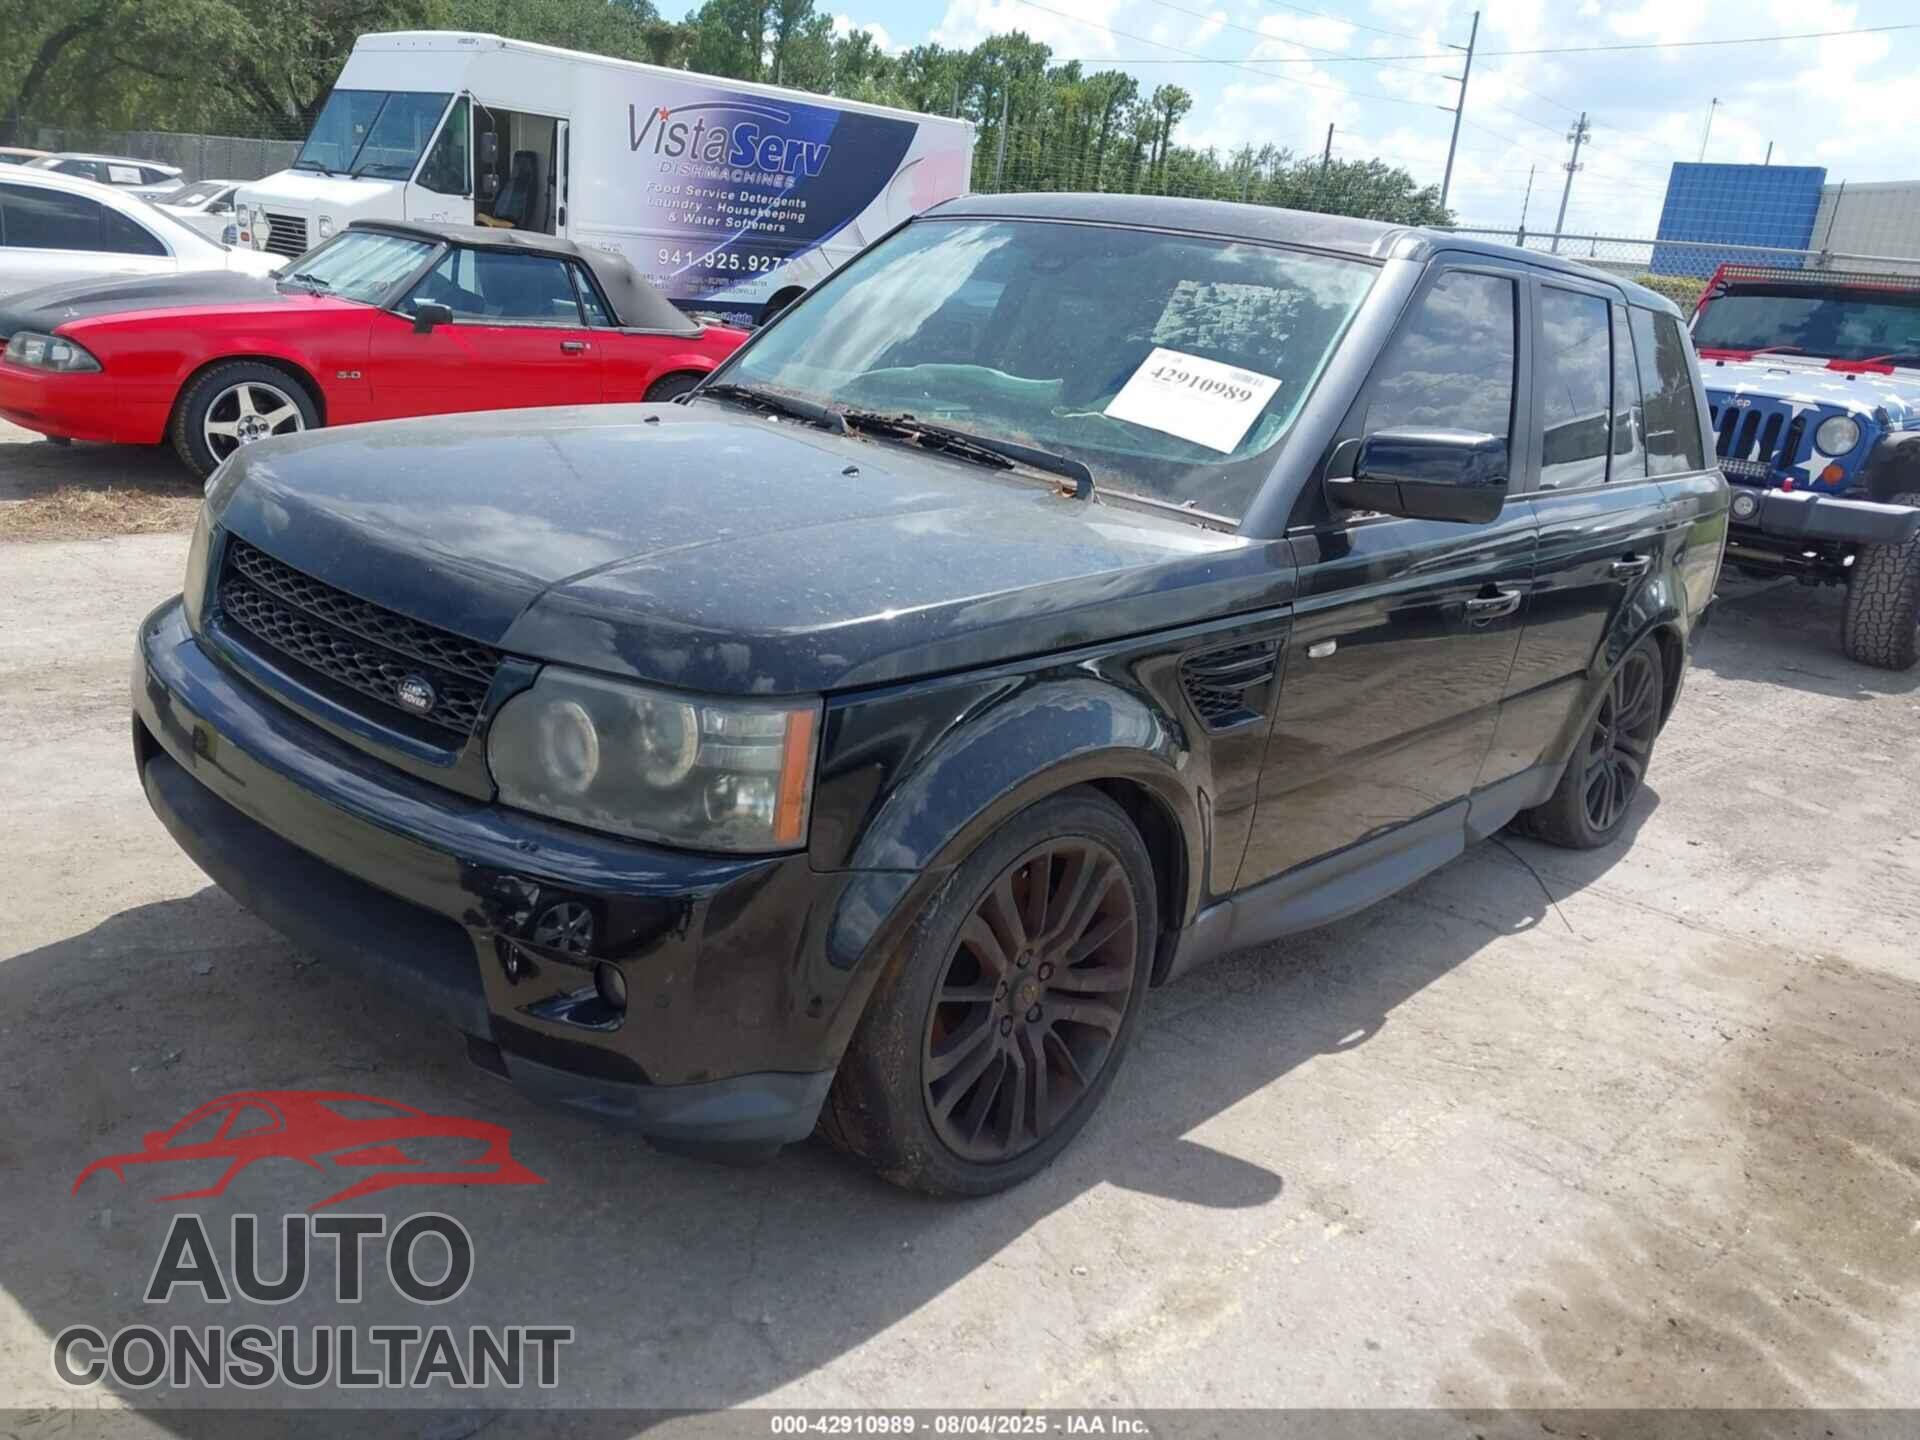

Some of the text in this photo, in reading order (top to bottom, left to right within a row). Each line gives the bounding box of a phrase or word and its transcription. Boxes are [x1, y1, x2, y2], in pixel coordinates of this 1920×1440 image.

[628, 103, 831, 177] VistaServ
[647, 182, 807, 209] Food Service Detergents
[647, 197, 702, 212] Laundry
[717, 202, 806, 223] Housekeeping
[668, 213, 785, 233] & Water Softeners
[1151, 366, 1252, 402] 42910989
[402, 692, 427, 707] ROVER
